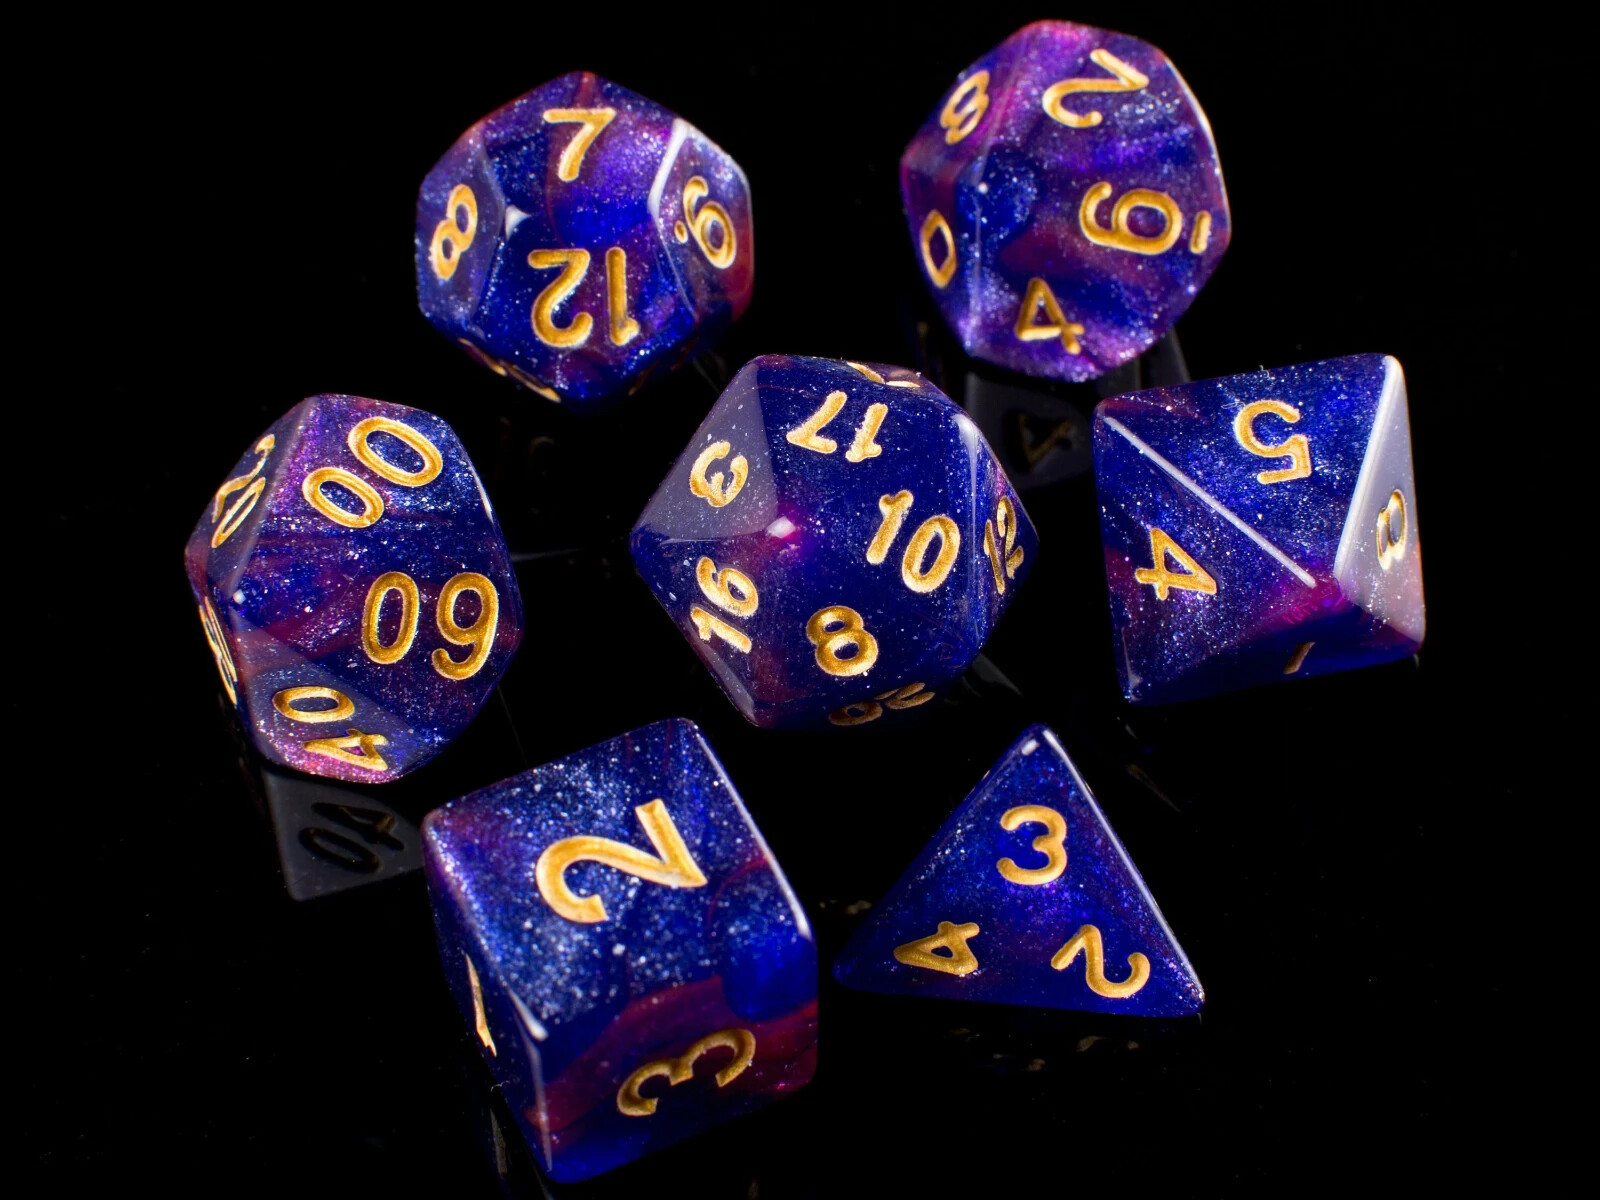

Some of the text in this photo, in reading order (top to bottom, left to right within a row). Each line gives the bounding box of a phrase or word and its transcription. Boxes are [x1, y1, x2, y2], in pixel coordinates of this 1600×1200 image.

[1043, 48, 1149, 128] 2
[543, 108, 616, 182] 7
[430, 184, 478, 281] 8
[920, 210, 957, 289] 0
[527, 247, 640, 348] 12
[1016, 278, 1085, 354] 4
[786, 390, 889, 463] 17
[1234, 400, 1312, 485] 5
[302, 415, 444, 529] 00
[689, 440, 750, 508] 3
[866, 490, 961, 593] 10
[984, 496, 1025, 595] 12
[1135, 528, 1217, 601] 4
[690, 556, 760, 654] 16
[806, 605, 879, 677] 8
[535, 798, 708, 924] 2
[996, 804, 1068, 886] 3
[893, 920, 981, 976] 4
[1050, 924, 1151, 999] 2
[616, 1028, 757, 1118] 3
